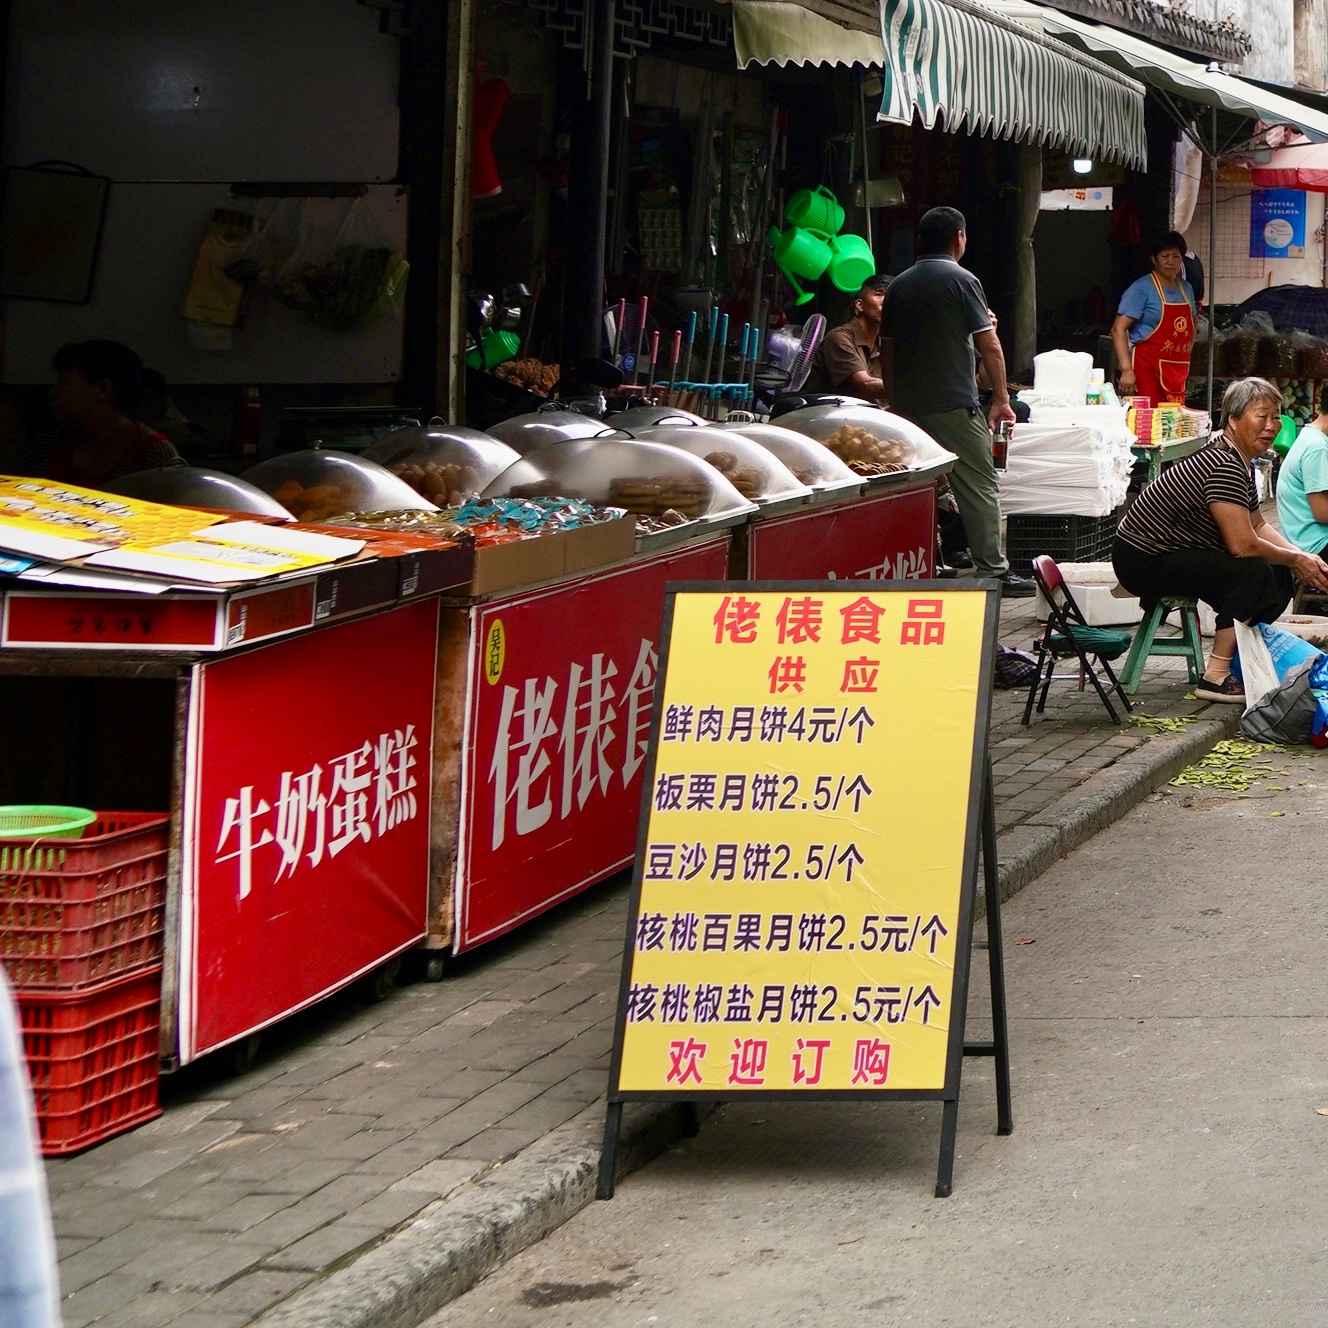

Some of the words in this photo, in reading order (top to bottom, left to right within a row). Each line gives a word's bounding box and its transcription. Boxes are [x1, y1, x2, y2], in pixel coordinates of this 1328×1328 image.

[713, 596, 946, 646] 佬俵食品
[488, 628, 503, 678] 吴记
[767, 655, 881, 694] 供应
[662, 704, 875, 744] 鲜肉月饼4元/个
[215, 723, 419, 901] 牛奶蛋糕
[654, 773, 873, 813] 板栗月饼2.5/个
[643, 842, 865, 883] 豆沙月饼2.5/个
[634, 912, 949, 953] 核桃百果月饼2.5元/个
[625, 983, 942, 1025] 核桃椒盐月饼2.5元/个
[666, 1037, 892, 1087] 欢迎订购
